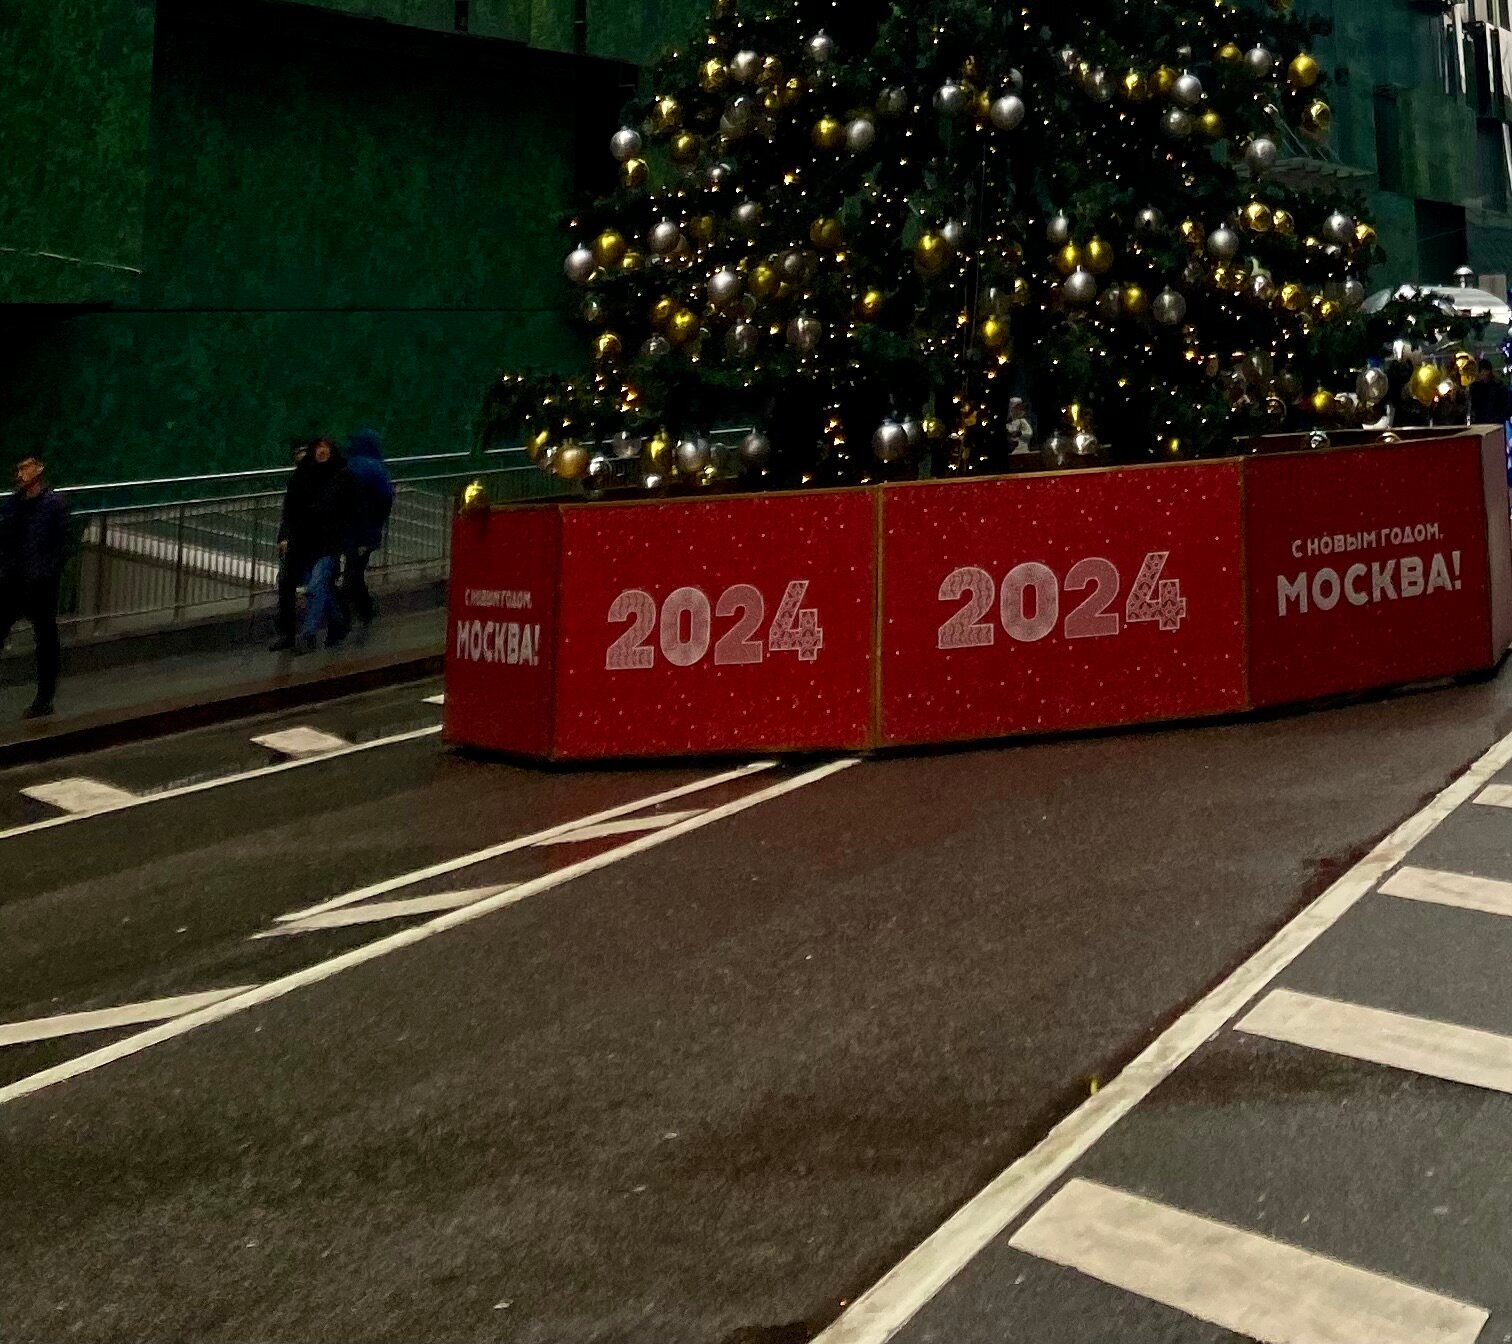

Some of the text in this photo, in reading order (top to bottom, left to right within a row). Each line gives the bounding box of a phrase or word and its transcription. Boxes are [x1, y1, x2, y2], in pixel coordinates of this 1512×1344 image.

[1291, 539, 1302, 557] С
[1307, 531, 1376, 556] НОВЫМ
[938, 551, 1186, 649] 2024
[1277, 550, 1462, 616] МОСКВА!
[456, 619, 540, 666] МОСКВА!
[606, 580, 823, 670] 2024
